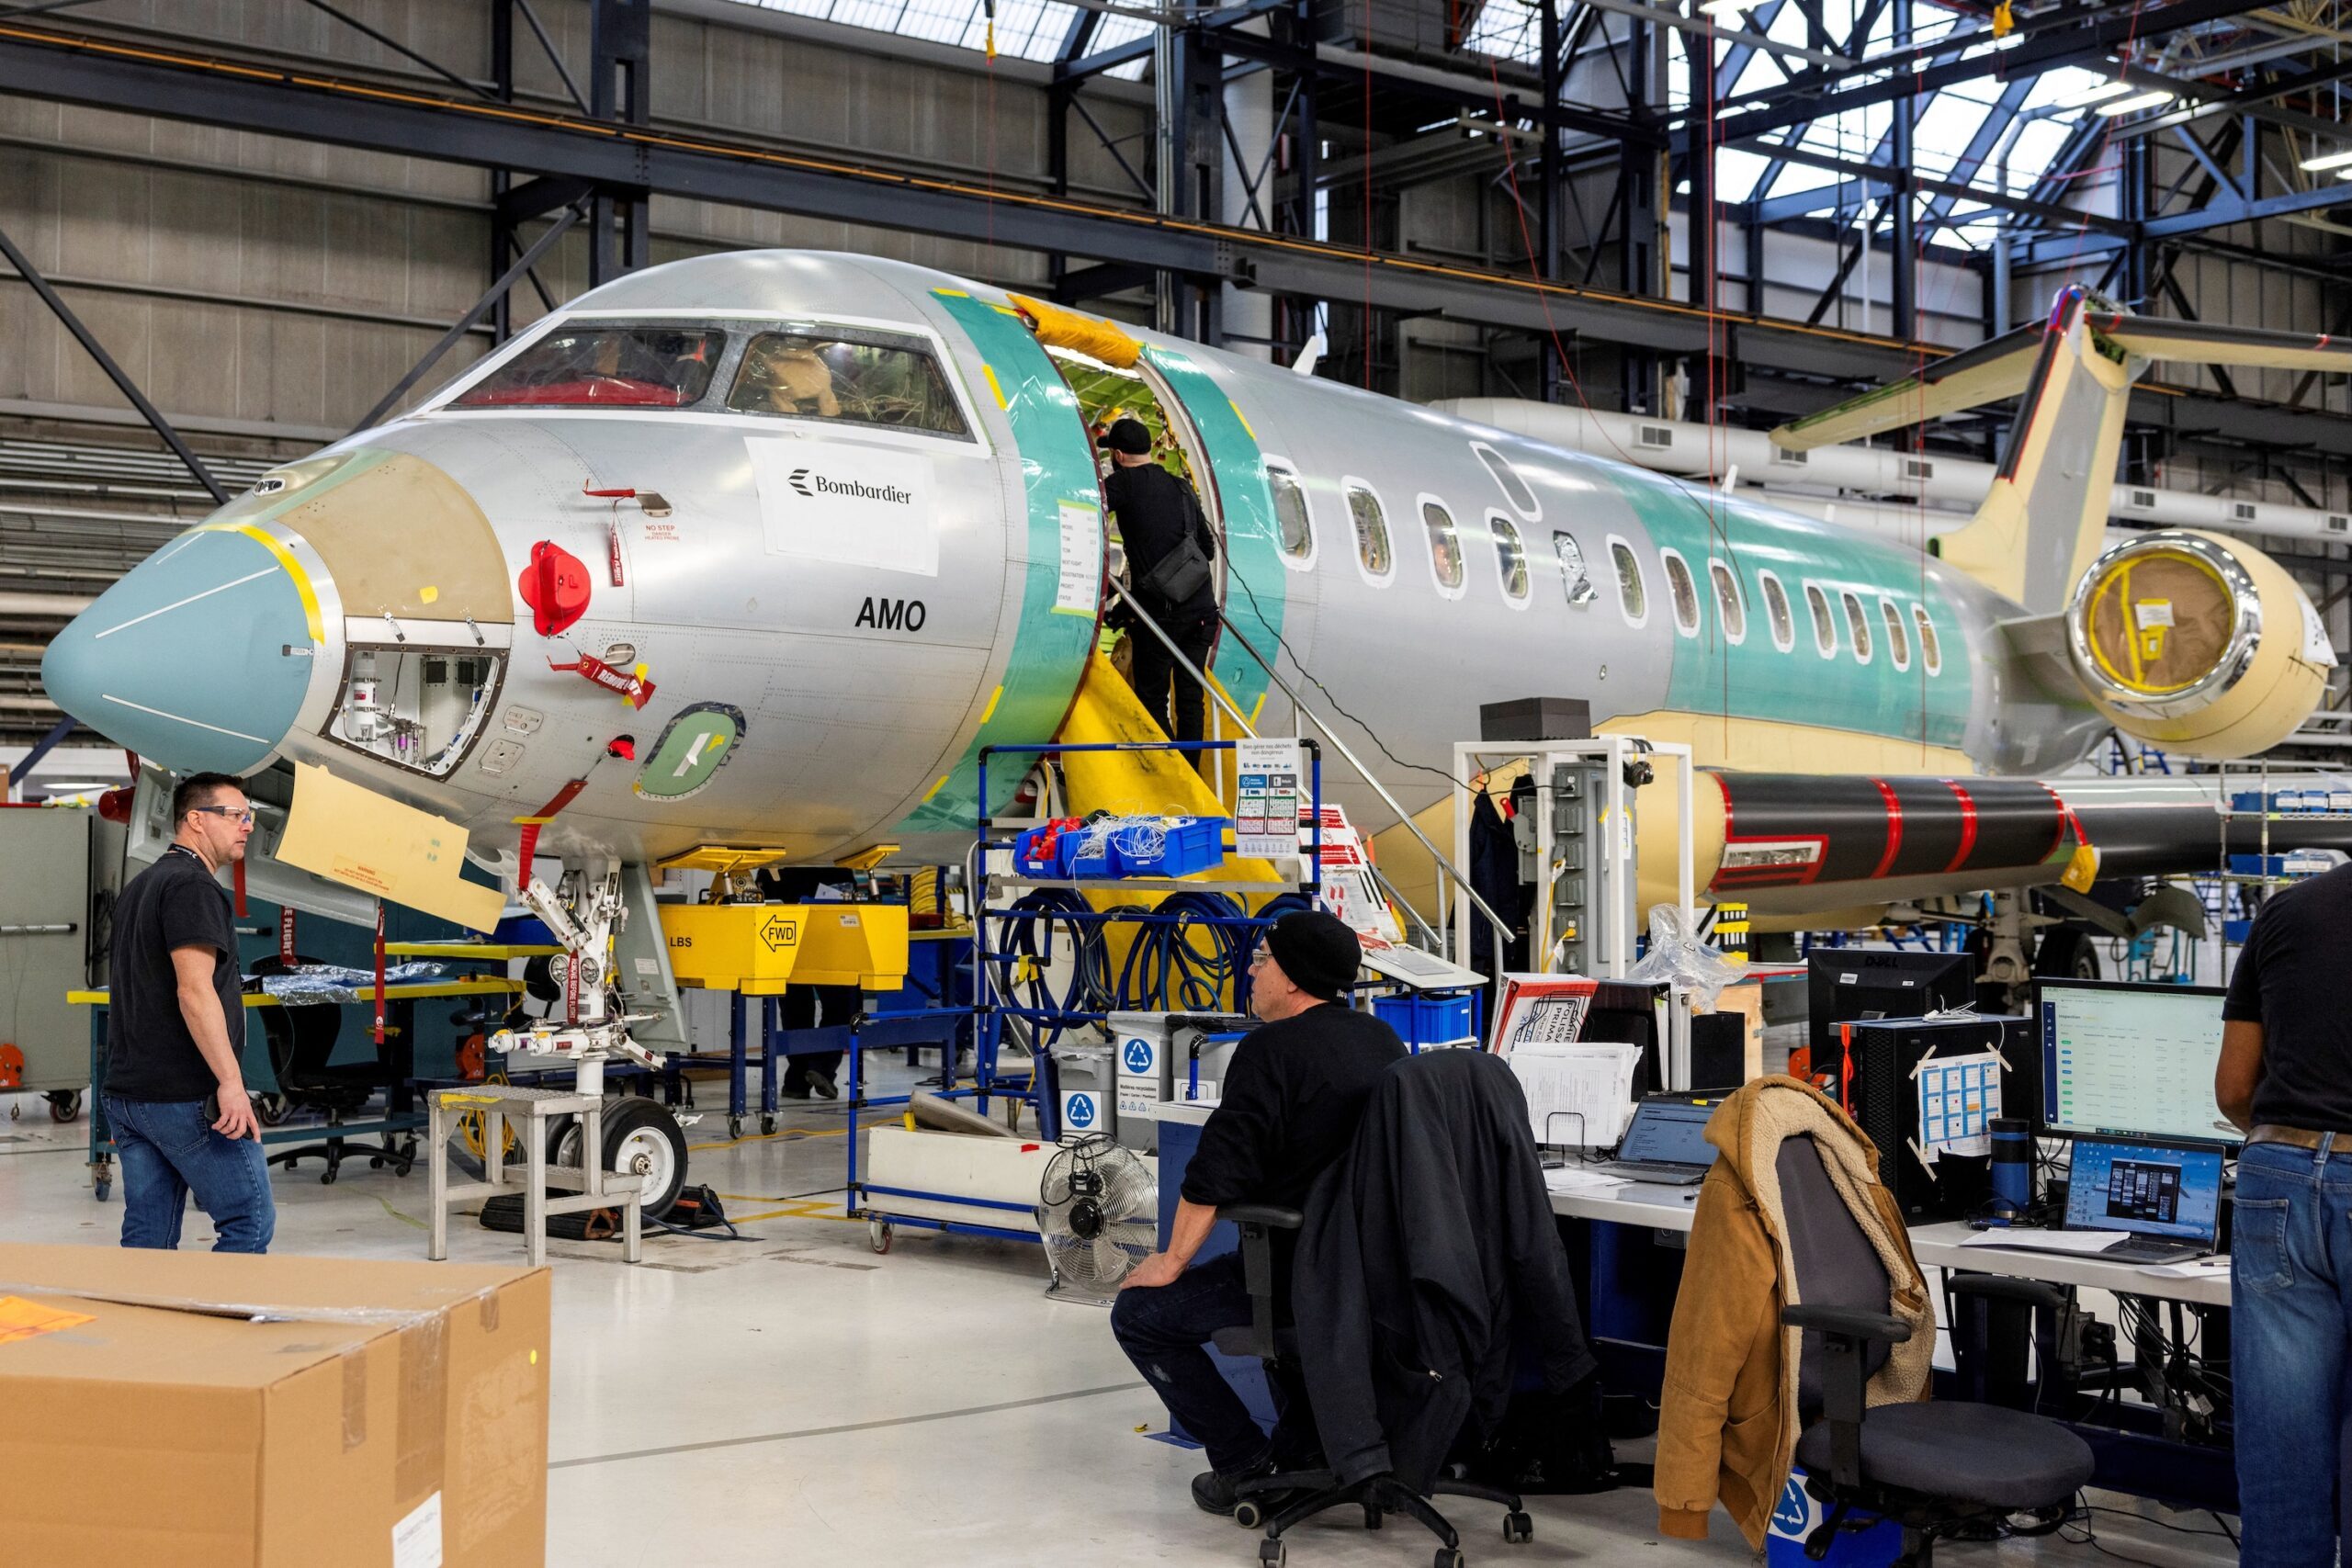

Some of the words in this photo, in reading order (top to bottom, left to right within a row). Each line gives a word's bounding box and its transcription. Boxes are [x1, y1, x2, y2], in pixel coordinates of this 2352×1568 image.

[816, 476, 911, 504] Bombardier
[854, 596, 926, 632] AMO
[283, 918, 293, 956] FLIGHT
[670, 937, 692, 947] LBS
[768, 927, 794, 941] FWD
[571, 958, 579, 980] REMOVE
[569, 980, 578, 1000] BEFORE
